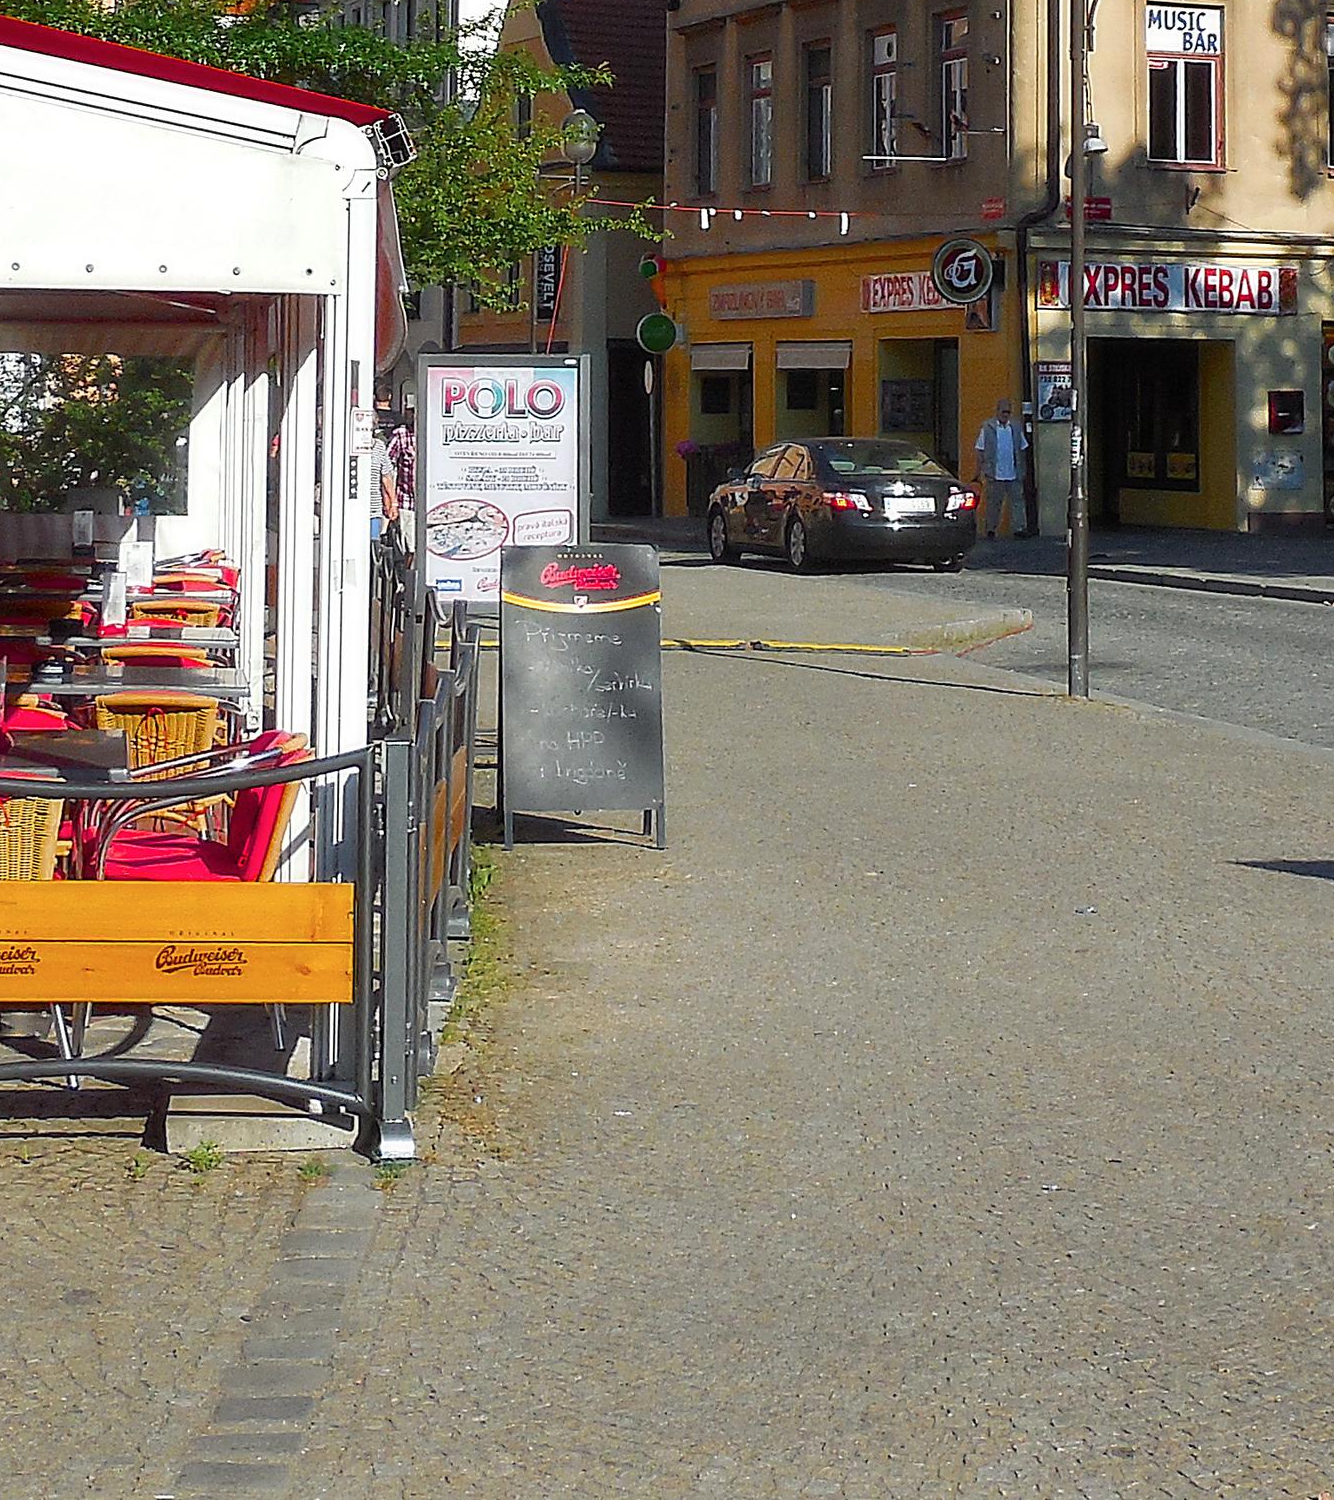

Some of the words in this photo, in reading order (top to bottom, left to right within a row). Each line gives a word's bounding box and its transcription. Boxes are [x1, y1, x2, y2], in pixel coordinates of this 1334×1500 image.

[1148, 9, 1206, 31] MUSIC
[1182, 32, 1218, 53] BAR
[872, 276, 914, 307] EXPRES
[1069, 265, 1170, 309] XPRES
[1185, 268, 1273, 310] KEBAB
[442, 377, 565, 419] POLO
[530, 422, 565, 444] bar
[155, 945, 248, 973] Budweiser
[193, 963, 244, 976] Budvar
